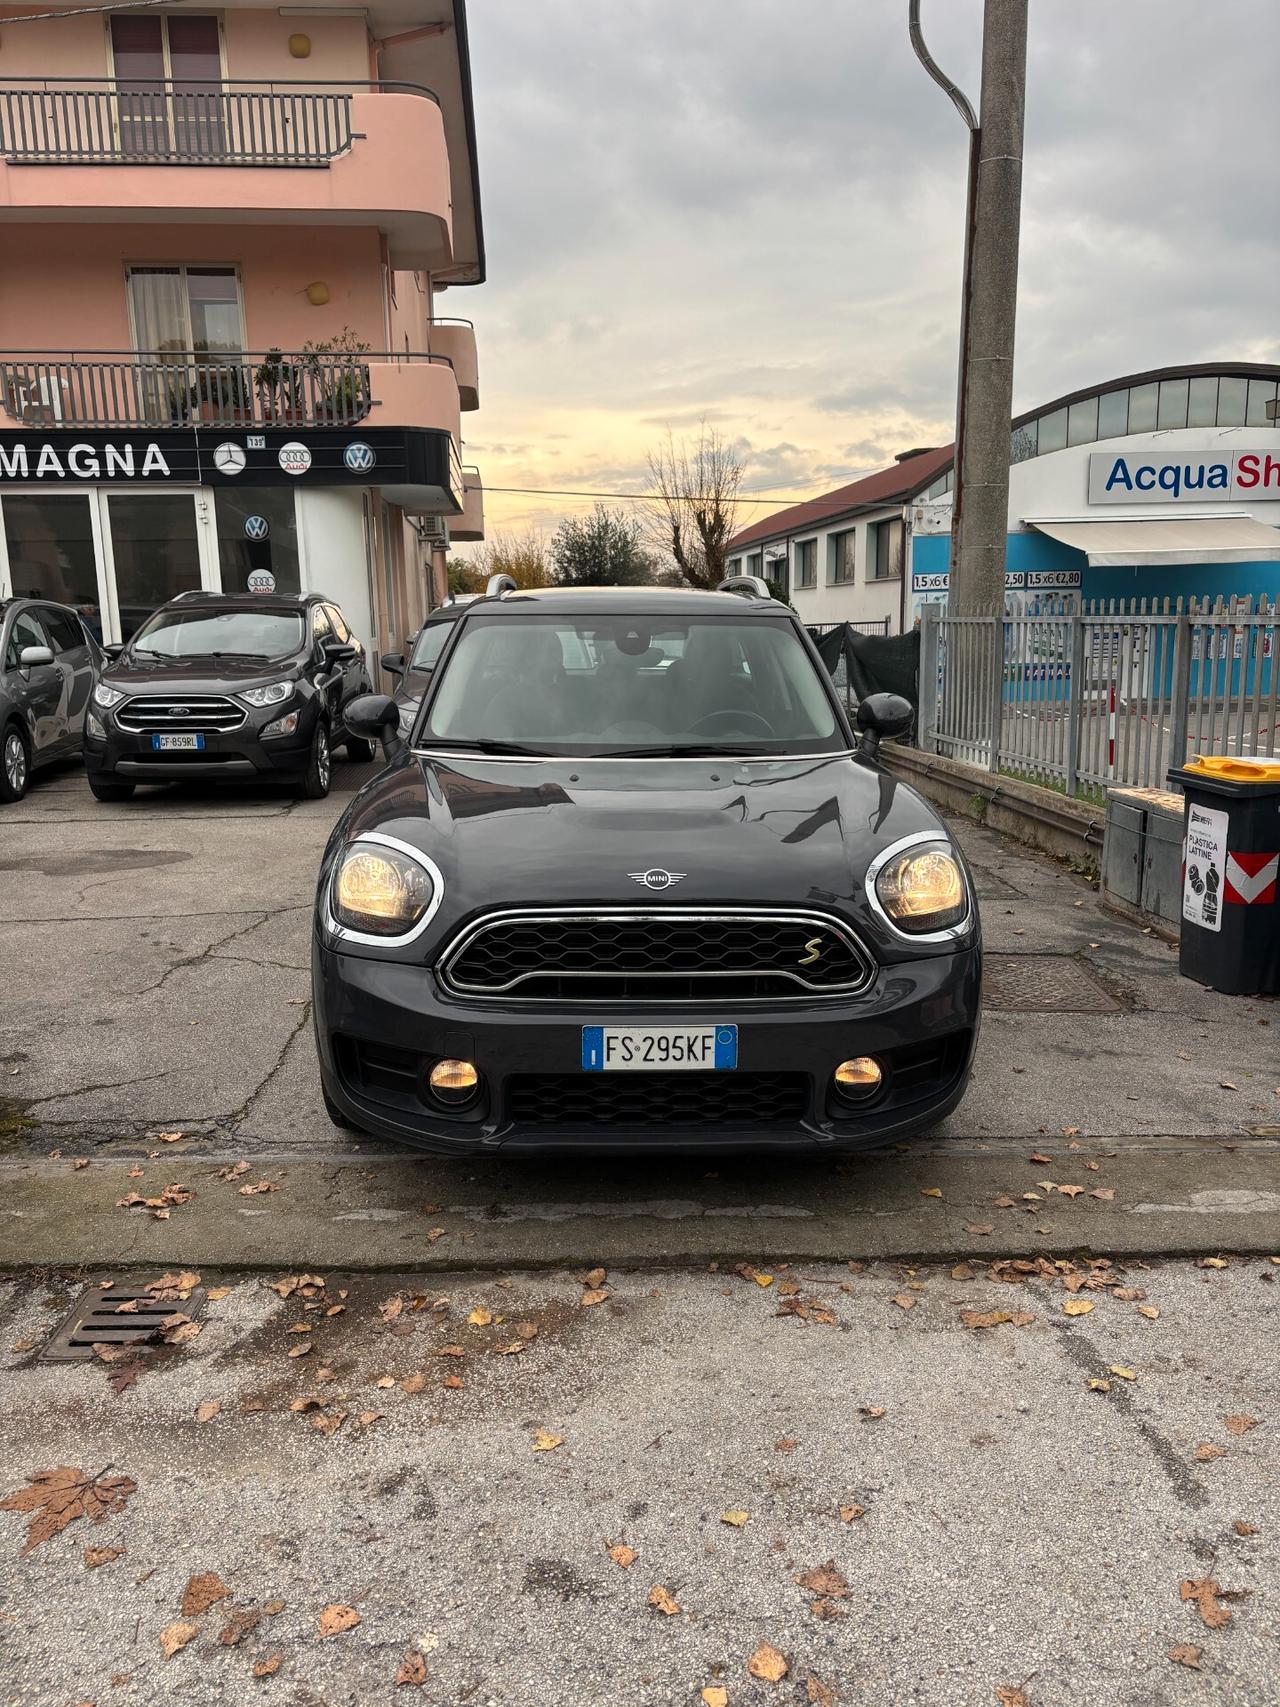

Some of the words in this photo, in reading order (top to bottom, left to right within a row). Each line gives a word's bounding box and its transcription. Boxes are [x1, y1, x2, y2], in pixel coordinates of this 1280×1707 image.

[0, 443, 171, 478] MAGNA
[1105, 457, 1228, 498] Acqua
[915, 576, 928, 588] 1,5
[929, 576, 941, 587] x6
[1029, 573, 1041, 586] 1,5
[1043, 573, 1054, 584] x6
[1056, 572, 1080, 585] €2,80
[1189, 834, 1218, 851] PLASTICA
[1188, 846, 1213, 861] LATTINE
[798, 938, 823, 965] S
